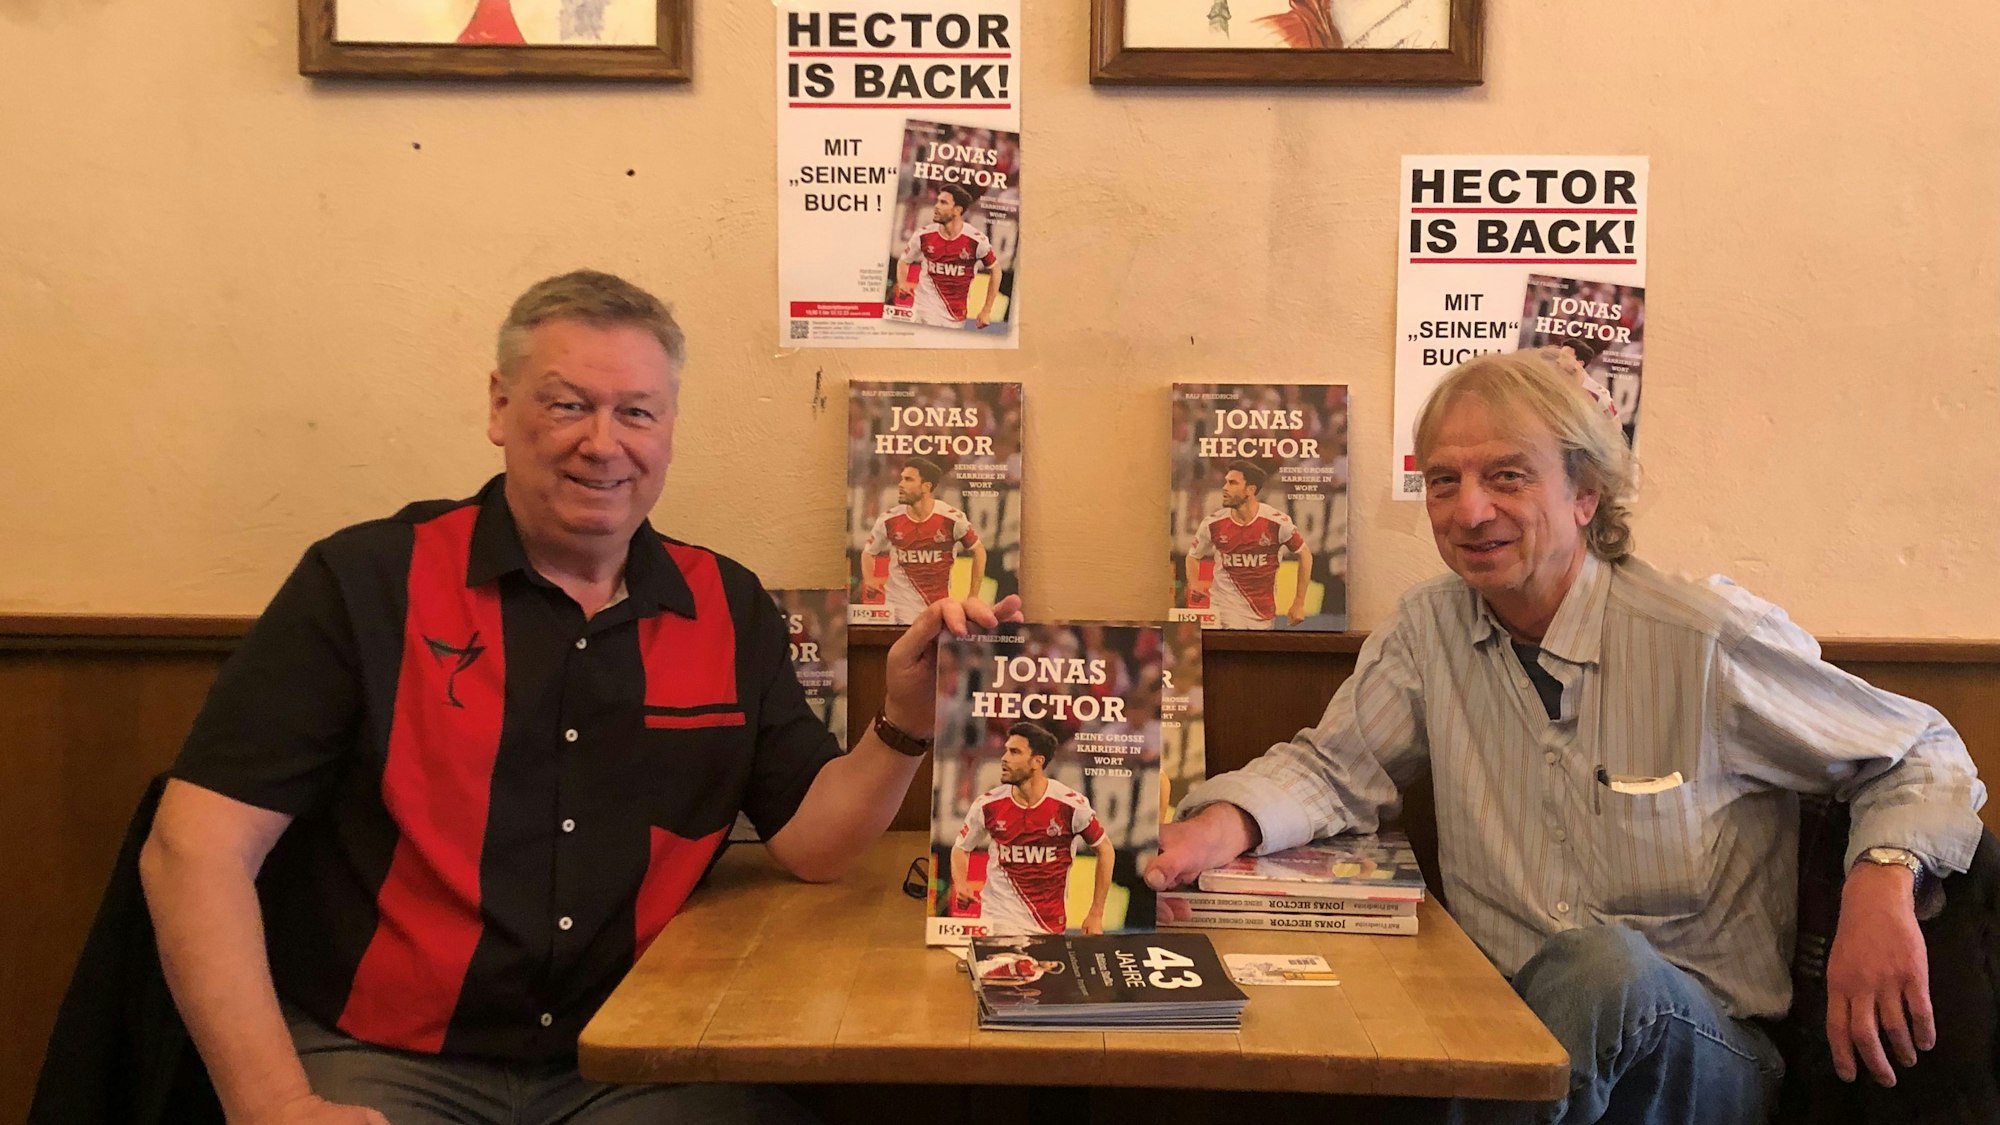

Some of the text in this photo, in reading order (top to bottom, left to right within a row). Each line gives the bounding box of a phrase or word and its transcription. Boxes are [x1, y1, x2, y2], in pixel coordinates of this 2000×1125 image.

[788, 12, 1011, 48] HECTOR
[788, 63, 1009, 99] IS BACK!
[824, 139, 862, 156] MIT
[927, 142, 998, 166] JONAS
[913, 162, 1008, 189] HECTOR
[1412, 169, 1637, 204] HECTOR
[805, 194, 868, 211] BUCH
[1410, 219, 1635, 254] IS BACK!
[929, 262, 966, 277] REWE
[1445, 294, 1484, 311] MIT
[1549, 296, 1623, 321] JONAS
[1535, 317, 1632, 344] HECTOR
[890, 407, 978, 432] JONAS
[1214, 409, 1303, 435] JONAS
[875, 434, 995, 456] HECTOR
[1199, 438, 1320, 458] HECTOR
[900, 550, 943, 564] REWE
[1223, 553, 1267, 567] REWE
[977, 635, 1025, 643] FRIEDRICHS
[992, 655, 1107, 688] JONAS
[972, 691, 1127, 722] HECTOR
[1074, 732, 1145, 743] SEINE GROSSE
[1077, 744, 1141, 754] KARRIERE IN
[1094, 756, 1124, 765] WORT
[1084, 768, 1132, 777] UND BILD
[999, 844, 1057, 864] REWE
[1269, 900, 1311, 908] HECTOR
[1314, 901, 1344, 910] JONAS
[1270, 919, 1312, 927] HECTOR
[1315, 920, 1345, 929] JONAS
[1114, 950, 1146, 989] JAHRE
[1143, 946, 1203, 990] 43
